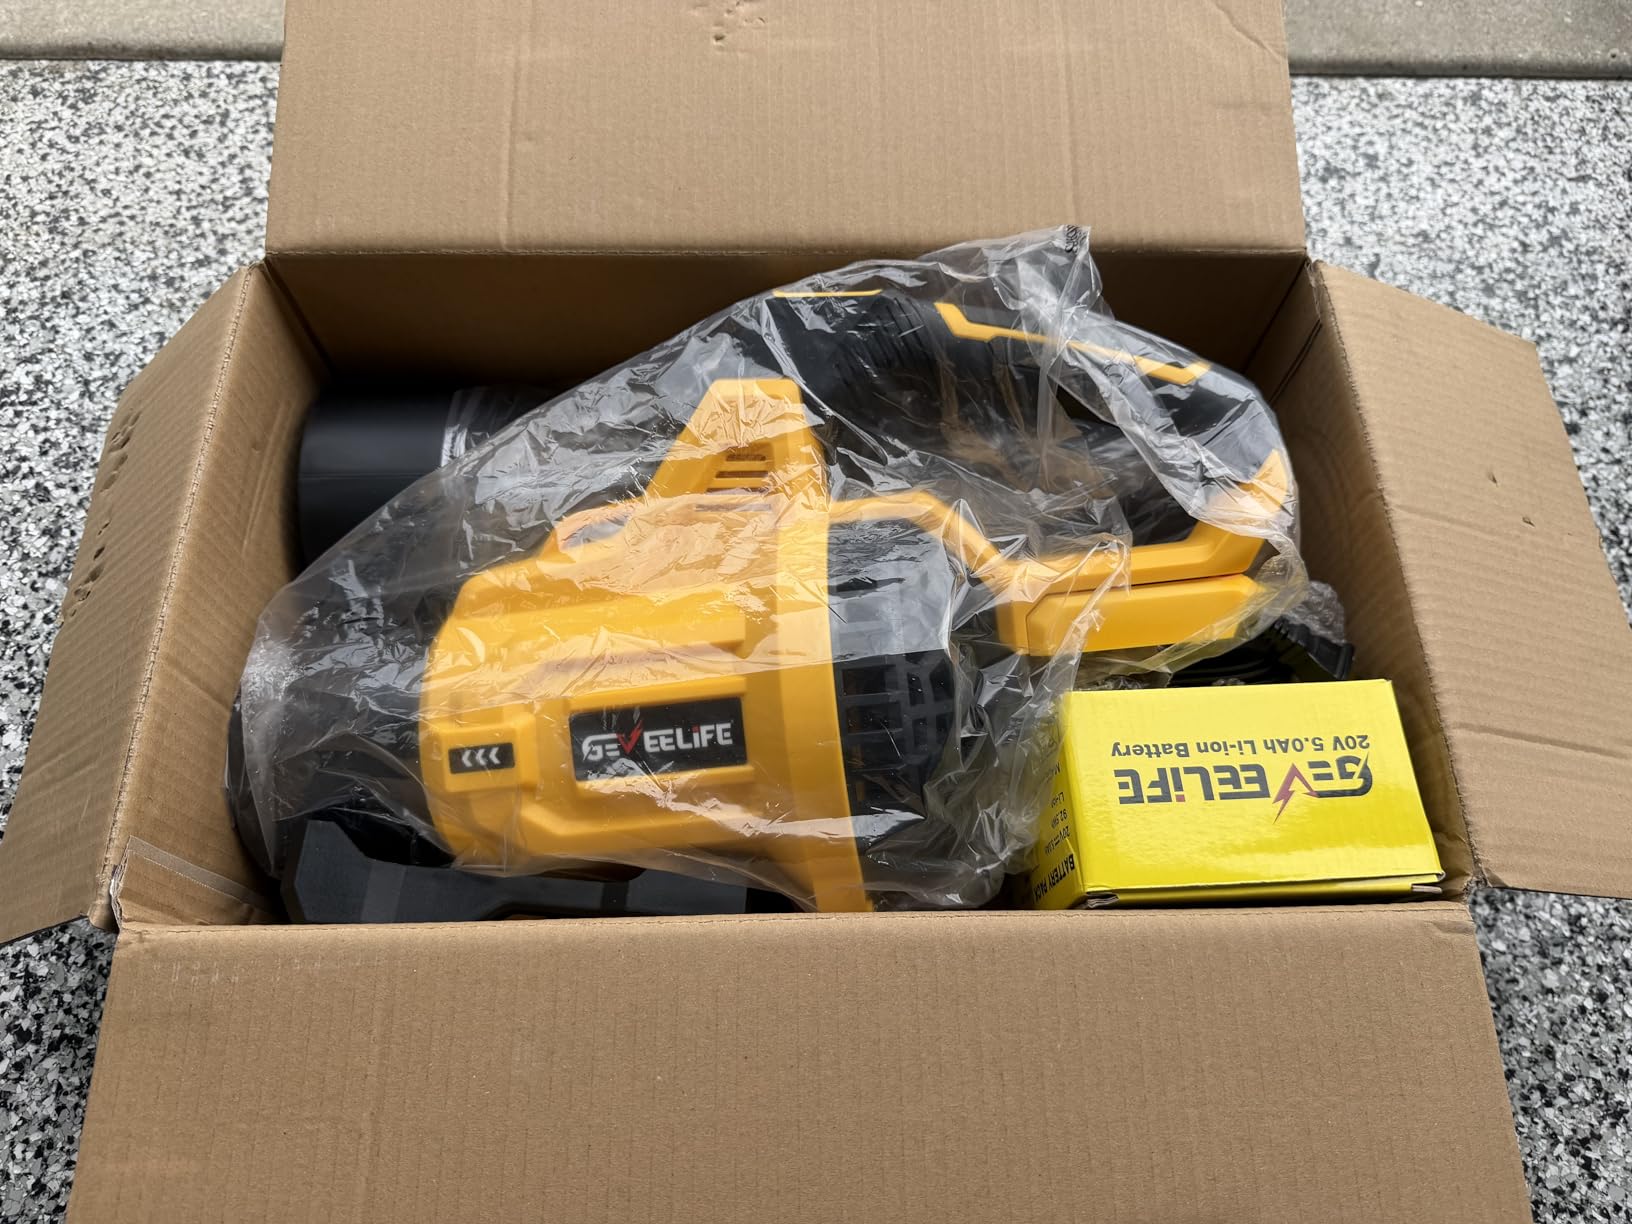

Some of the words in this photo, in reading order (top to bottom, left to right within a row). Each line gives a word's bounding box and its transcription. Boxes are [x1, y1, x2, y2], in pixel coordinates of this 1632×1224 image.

[1111, 742, 1190, 758] Battery
[1196, 739, 1257, 755] Li-ion
[1264, 736, 1324, 753] 5.0Ah
[1332, 735, 1371, 750] 20V
[1048, 854, 1075, 889] BATTERY
[1033, 876, 1048, 904] PACK
